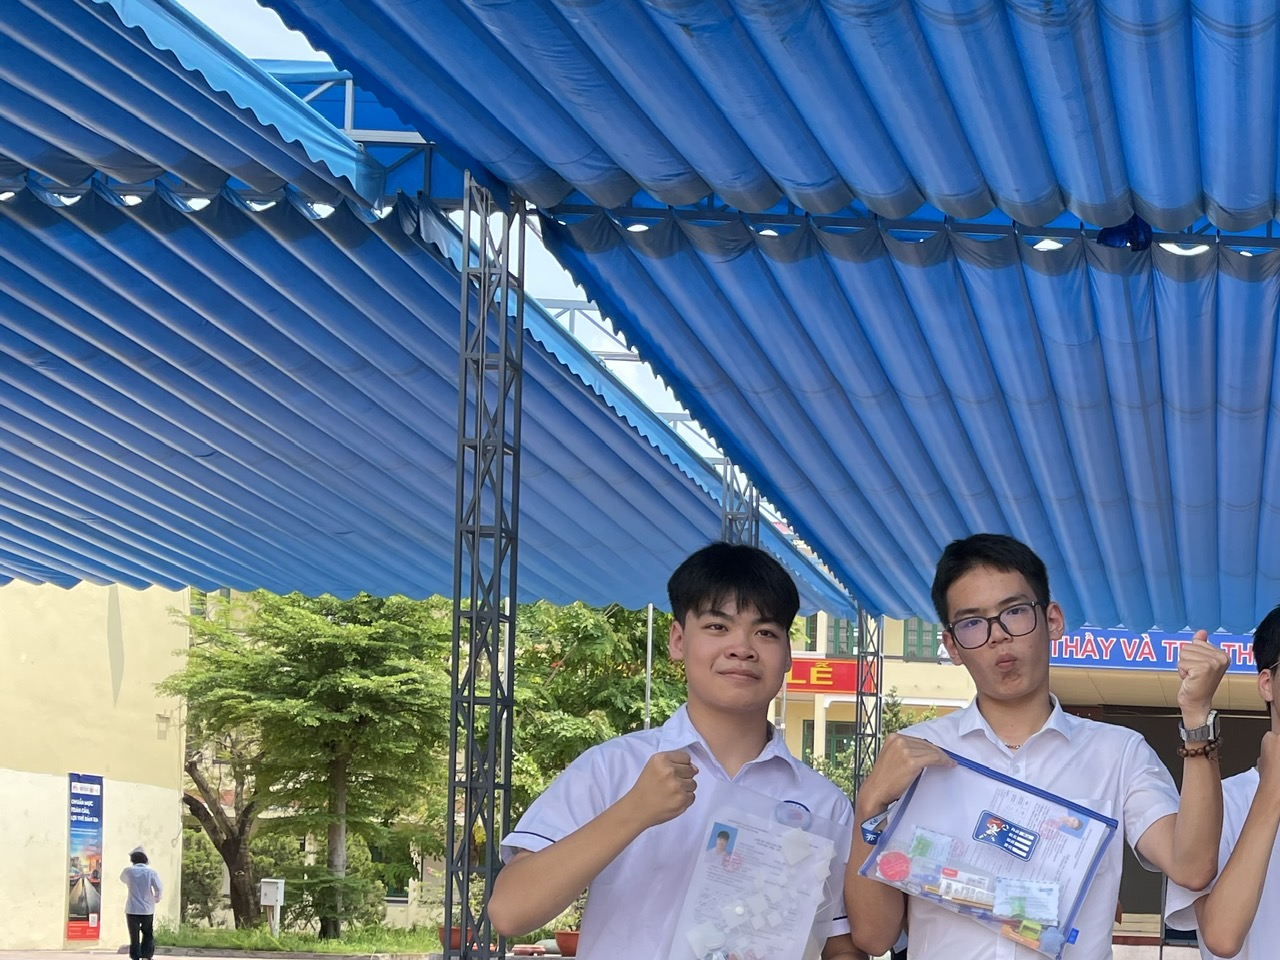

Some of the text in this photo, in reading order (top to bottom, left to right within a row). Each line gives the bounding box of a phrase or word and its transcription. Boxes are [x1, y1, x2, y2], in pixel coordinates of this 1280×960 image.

[1051, 632, 1117, 660] THẦY
[1120, 633, 1157, 662] VÀ
[1221, 642, 1258, 665] TH
